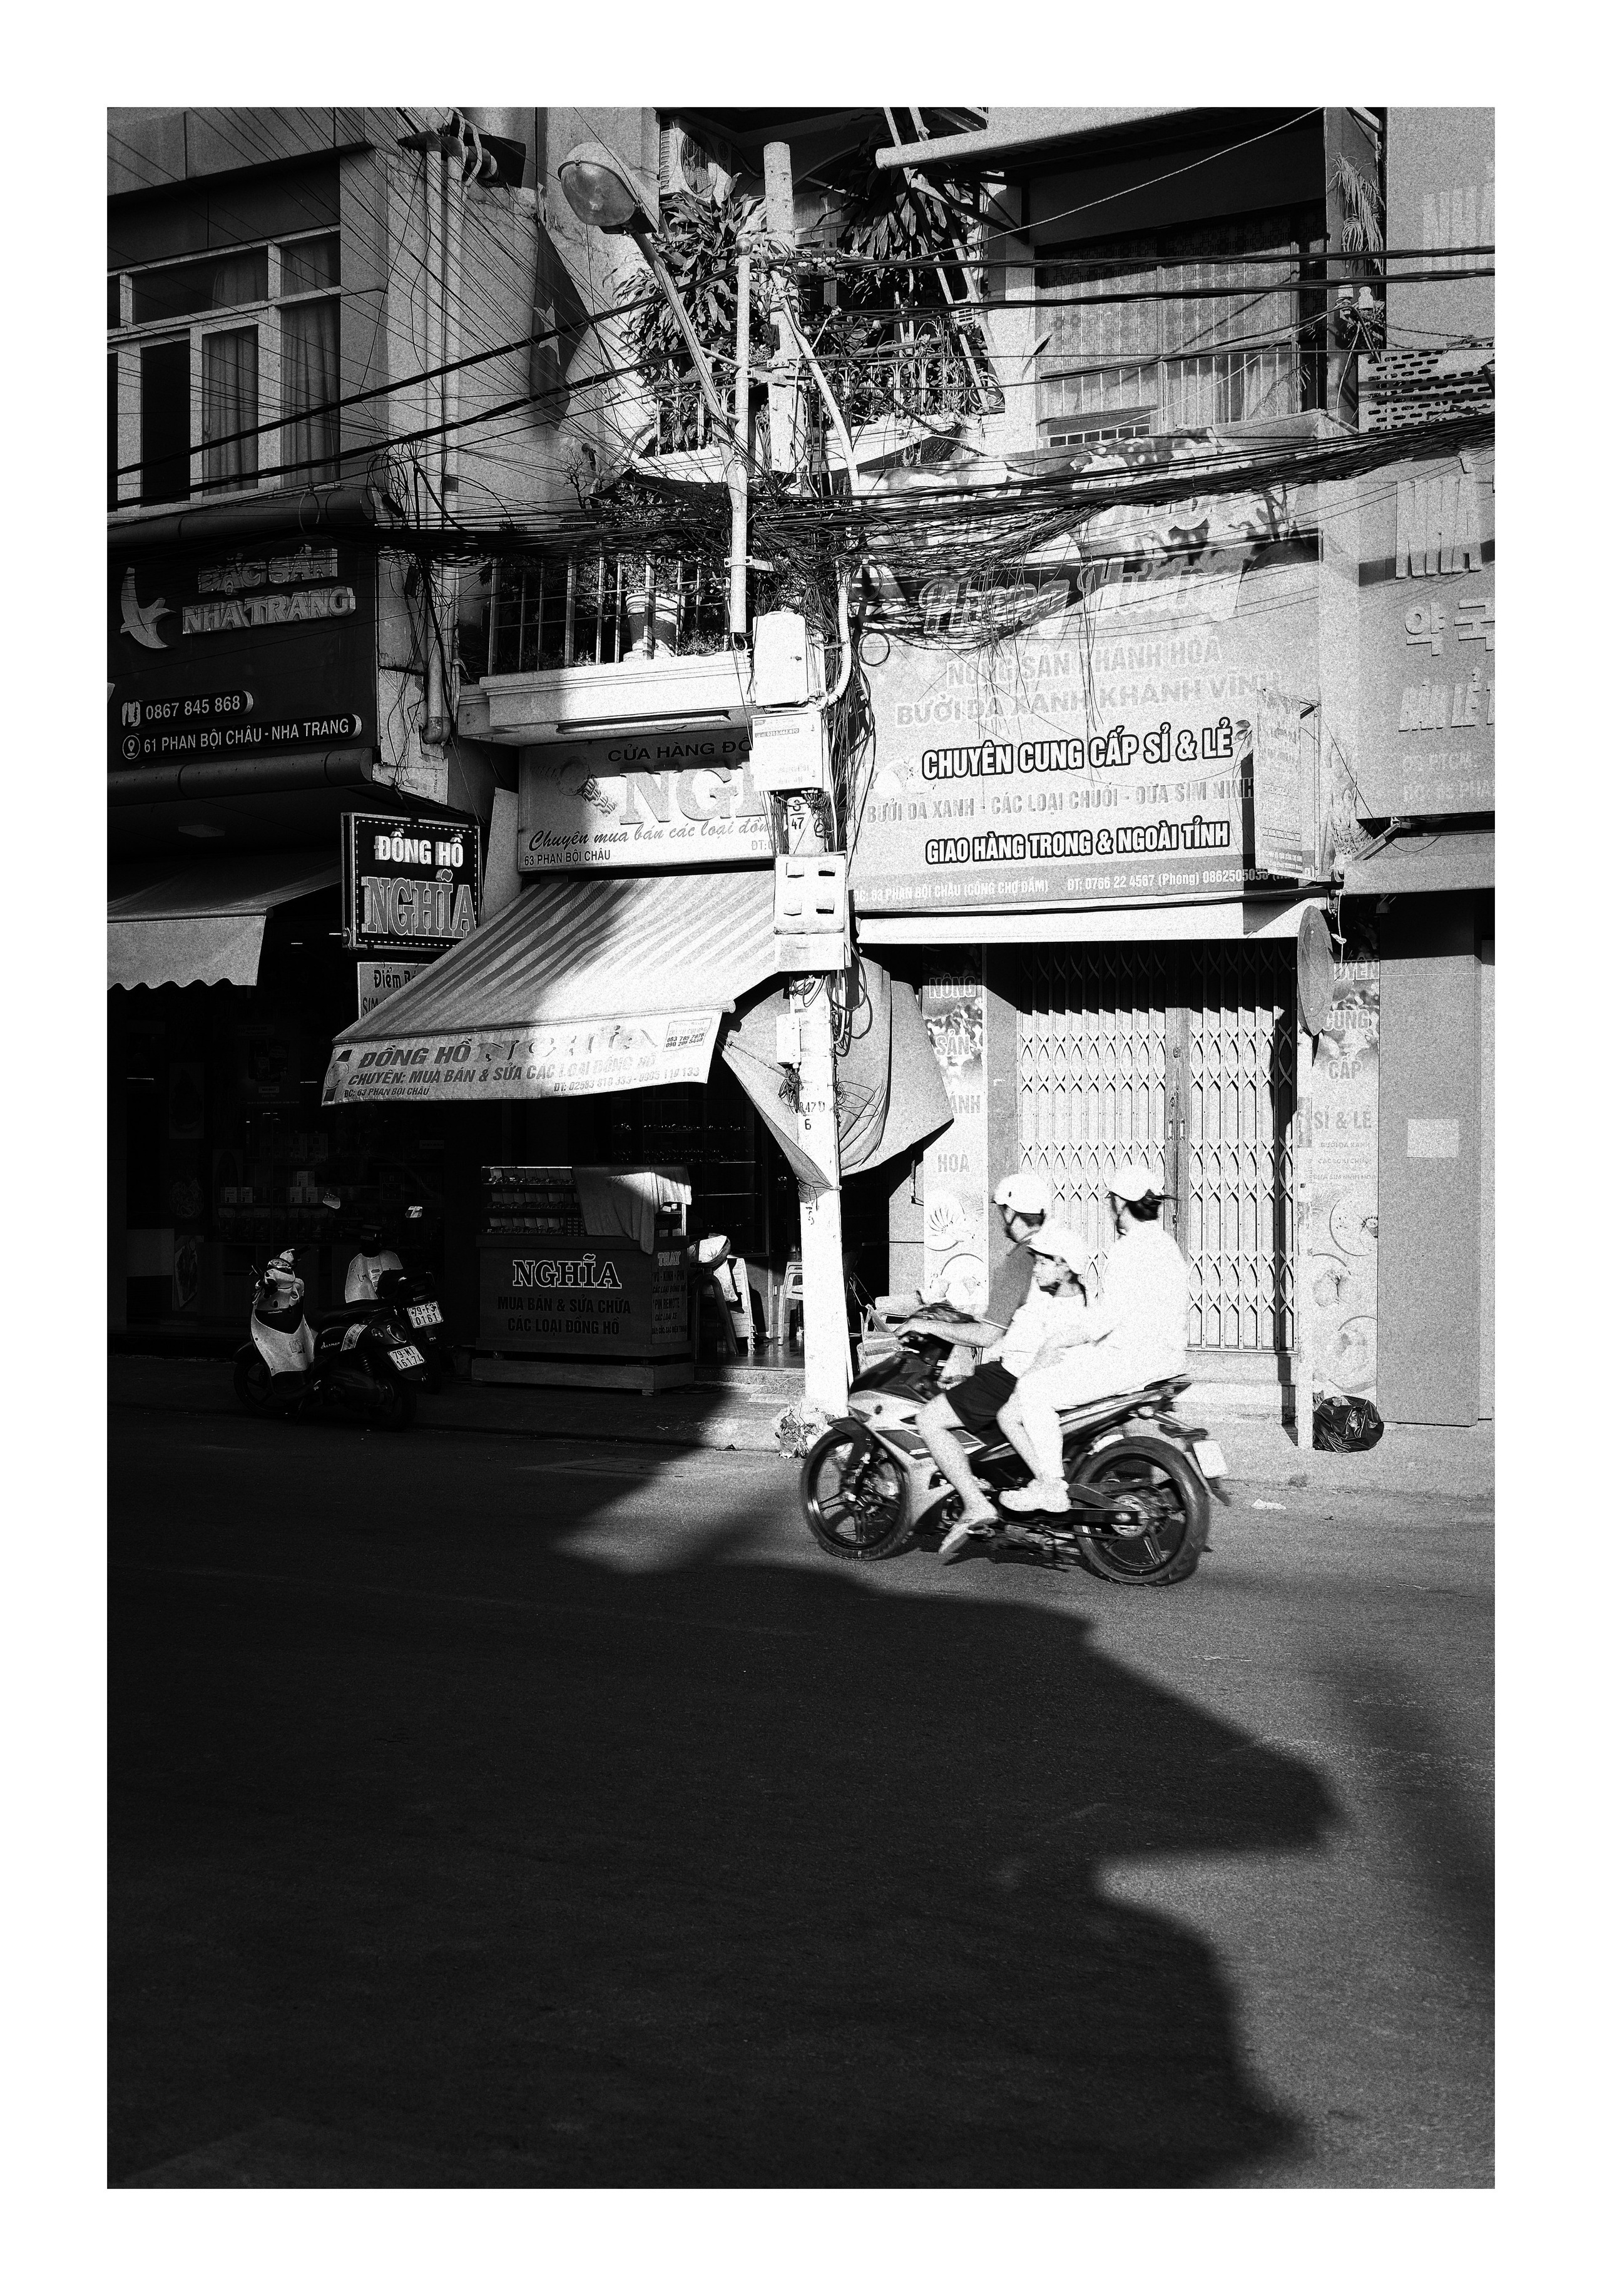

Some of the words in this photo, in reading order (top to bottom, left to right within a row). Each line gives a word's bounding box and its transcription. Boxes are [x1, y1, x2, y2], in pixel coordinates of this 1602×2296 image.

[146, 702, 179, 719] 0867
[185, 698, 210, 715] 845
[215, 695, 240, 712] 868
[896, 693, 961, 727] BƯỞI
[144, 738, 156, 753] 61
[161, 734, 196, 752] PHAN
[200, 728, 222, 750] BỘI
[226, 725, 262, 745] CHÂU
[272, 723, 299, 740] NHA
[304, 718, 349, 737] TRANG
[608, 743, 649, 763] CỬA
[656, 742, 715, 759] HÀNG
[922, 740, 1013, 780] CHUYÊN
[1018, 738, 1084, 773] CUNG
[1088, 725, 1139, 768] CẤP
[1143, 722, 1171, 763] SỈ
[1176, 730, 1197, 761] &
[1202, 717, 1233, 759] LẺ
[867, 798, 902, 824] BƯỞI
[932, 798, 974, 819] XANH
[991, 792, 1022, 815] CÁC
[1028, 792, 1063, 815] LOẠI
[1068, 782, 1118, 810] CHUỐI
[1213, 777, 1253, 800] NINH
[529, 830, 589, 852] Chuyên
[594, 830, 630, 845] mua
[634, 823, 665, 840] bán
[669, 821, 696, 837] các
[701, 820, 734, 840] loại
[791, 817, 805, 838] 47
[374, 828, 432, 865] ĐỒNG
[436, 834, 463, 867] HỒ
[926, 837, 970, 865] GIAO
[972, 831, 1026, 862] HÀNG
[1028, 830, 1093, 859] TRONG
[1096, 829, 1114, 856] &
[1116, 820, 1178, 853] NGOÀI
[1181, 815, 1230, 850] TỈNH
[524, 854, 535, 867] 63
[537, 852, 563, 865] PHAN
[565, 849, 583, 865] BỘI
[584, 849, 611, 861] CHÂU
[885, 886, 912, 901] PHAN
[915, 884, 932, 900] BỘI
[934, 882, 961, 898] CHÂU
[998, 879, 1019, 897] CHỢ
[1067, 878, 1082, 890] ĐT:
[1085, 877, 1110, 889] 0766
[1113, 875, 1126, 888] 22
[1129, 874, 1155, 887] 4567
[1158, 872, 1199, 887] (Phong)
[361, 869, 477, 939] NGHĨA
[374, 967, 402, 988] Điểm
[929, 973, 977, 999] NÔNG
[358, 1044, 429, 1069] ĐỒNG
[434, 1038, 472, 1064] HỒ
[935, 1028, 971, 1057] SẢN
[348, 1069, 406, 1086] CHUYÊN:
[408, 1071, 440, 1084] MUA
[444, 1066, 476, 1083] BÁN
[479, 1069, 489, 1082] &
[493, 1062, 522, 1081] SỬA
[526, 1063, 555, 1080] CÁC
[344, 1089, 355, 1098] ĐC:
[368, 1088, 389, 1096] PHAN
[390, 1086, 406, 1098] BỘI
[407, 1087, 430, 1096] CHÂU
[568, 1081, 594, 1091] 02583
[950, 1091, 981, 1115] ÁNH
[1336, 1111, 1347, 1130] &
[937, 1150, 971, 1173] HOÀ
[658, 1250, 681, 1267] THAY
[513, 1253, 622, 1289] NGHĨA
[676, 1270, 685, 1281] PIN
[412, 1302, 436, 1315] 79-F3
[497, 1296, 524, 1310] MUA
[528, 1294, 553, 1312] BÁN
[556, 1299, 566, 1312] &
[569, 1294, 594, 1313] SỬA
[598, 1297, 631, 1314] CHỮA
[663, 1297, 680, 1309] REMOTE
[415, 1314, 438, 1325] 0161
[508, 1315, 531, 1332] CÁC
[535, 1319, 562, 1336] LOẠI
[566, 1317, 599, 1334] ĐỒNG
[603, 1316, 620, 1335] HỒ
[396, 1354, 424, 1369] 161.74
